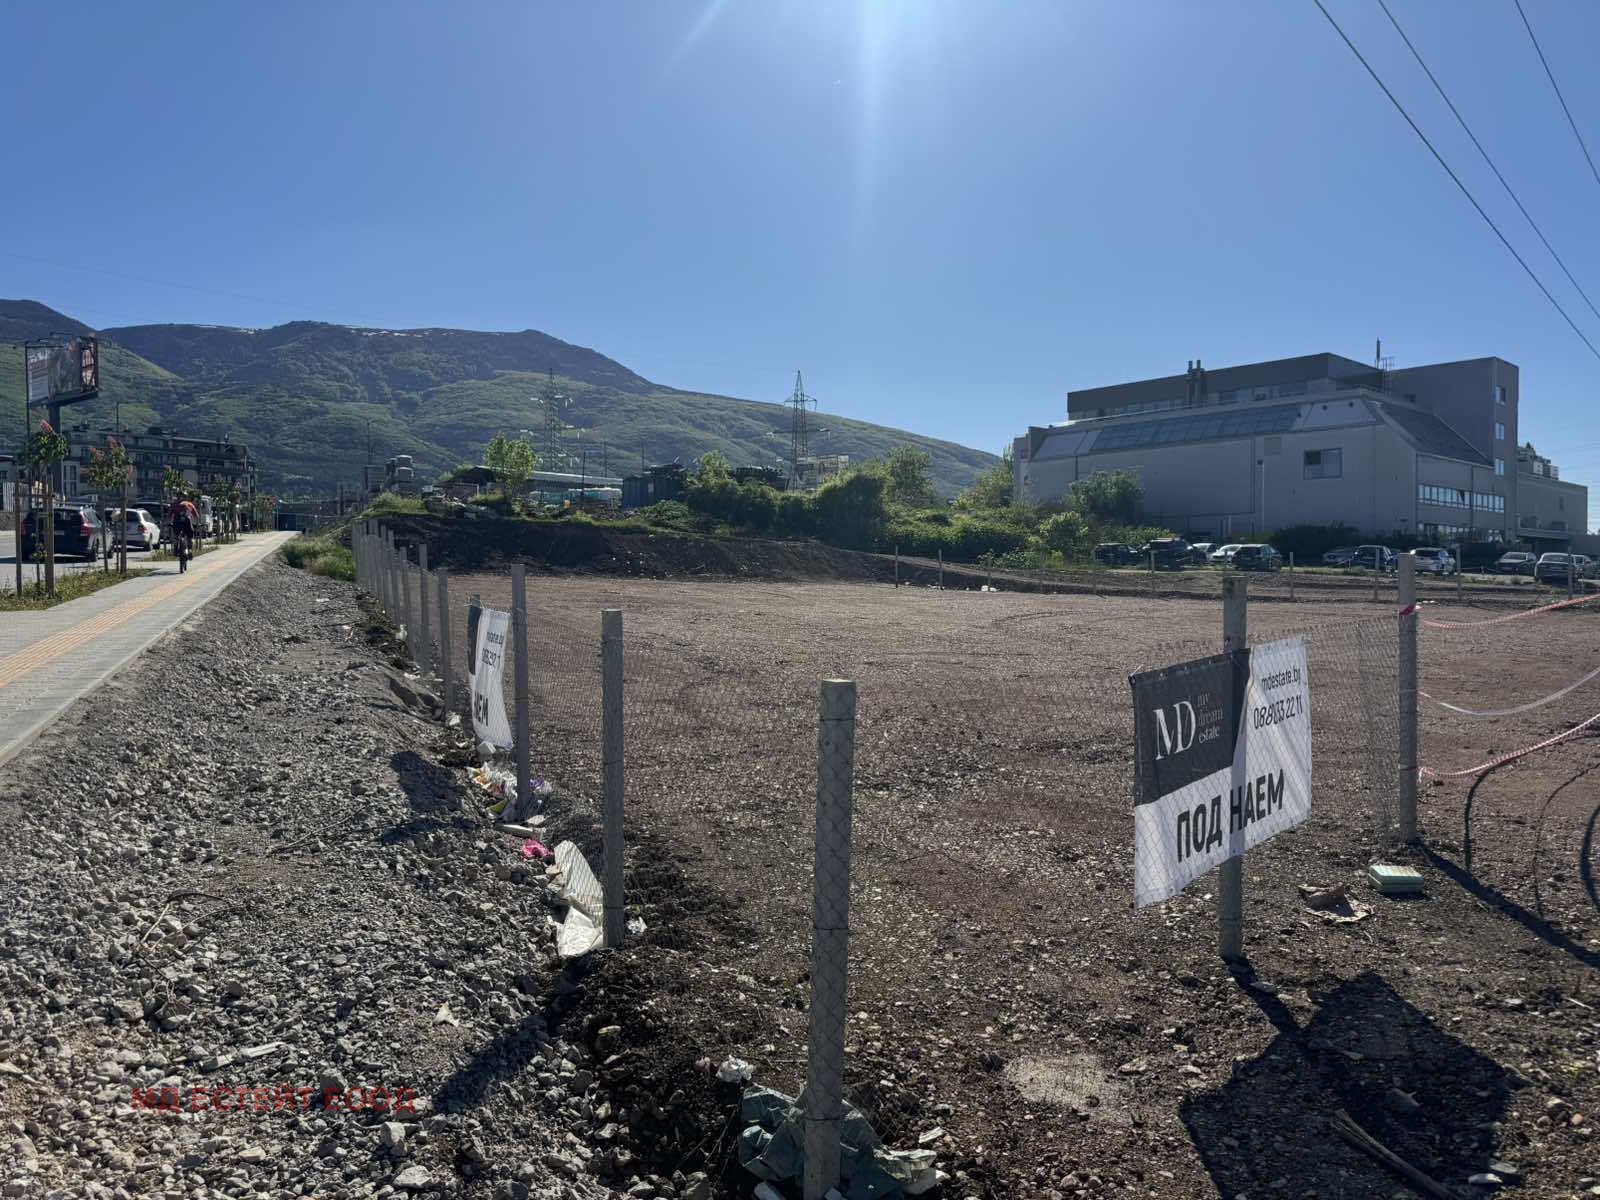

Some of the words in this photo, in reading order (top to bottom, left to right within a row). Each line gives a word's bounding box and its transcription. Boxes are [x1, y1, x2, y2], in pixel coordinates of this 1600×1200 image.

[1153, 701, 1196, 760] MD
[1177, 795, 1222, 863] ПОД
[1229, 769, 1284, 834] НАЕМ
